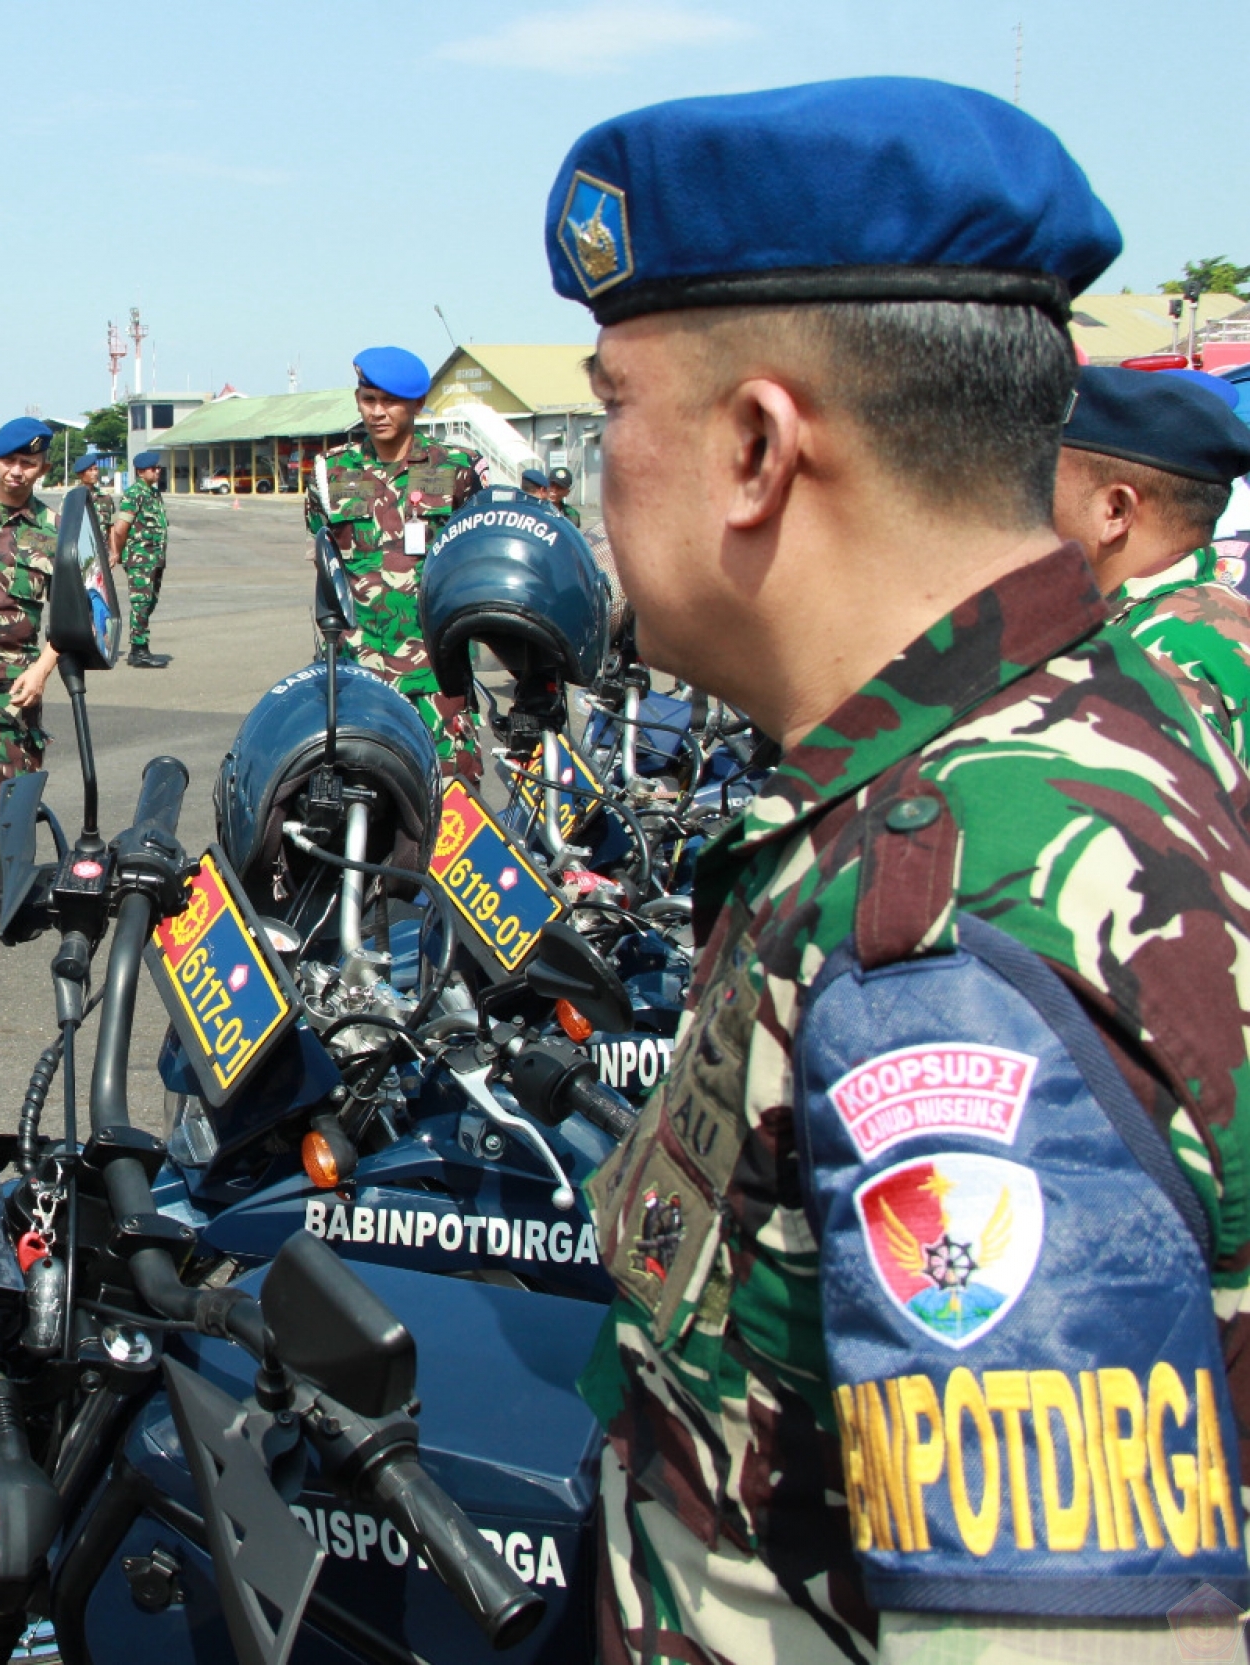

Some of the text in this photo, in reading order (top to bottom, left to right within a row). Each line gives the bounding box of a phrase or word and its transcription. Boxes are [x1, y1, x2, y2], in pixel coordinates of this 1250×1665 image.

[432, 510, 558, 557] BABINPOTDIRGA
[449, 858, 532, 959] 6119-01
[181, 947, 252, 1072] 6117-01
[856, 1105, 915, 1149] LANUD
[305, 1199, 599, 1266] BABINPOTDIRGA
